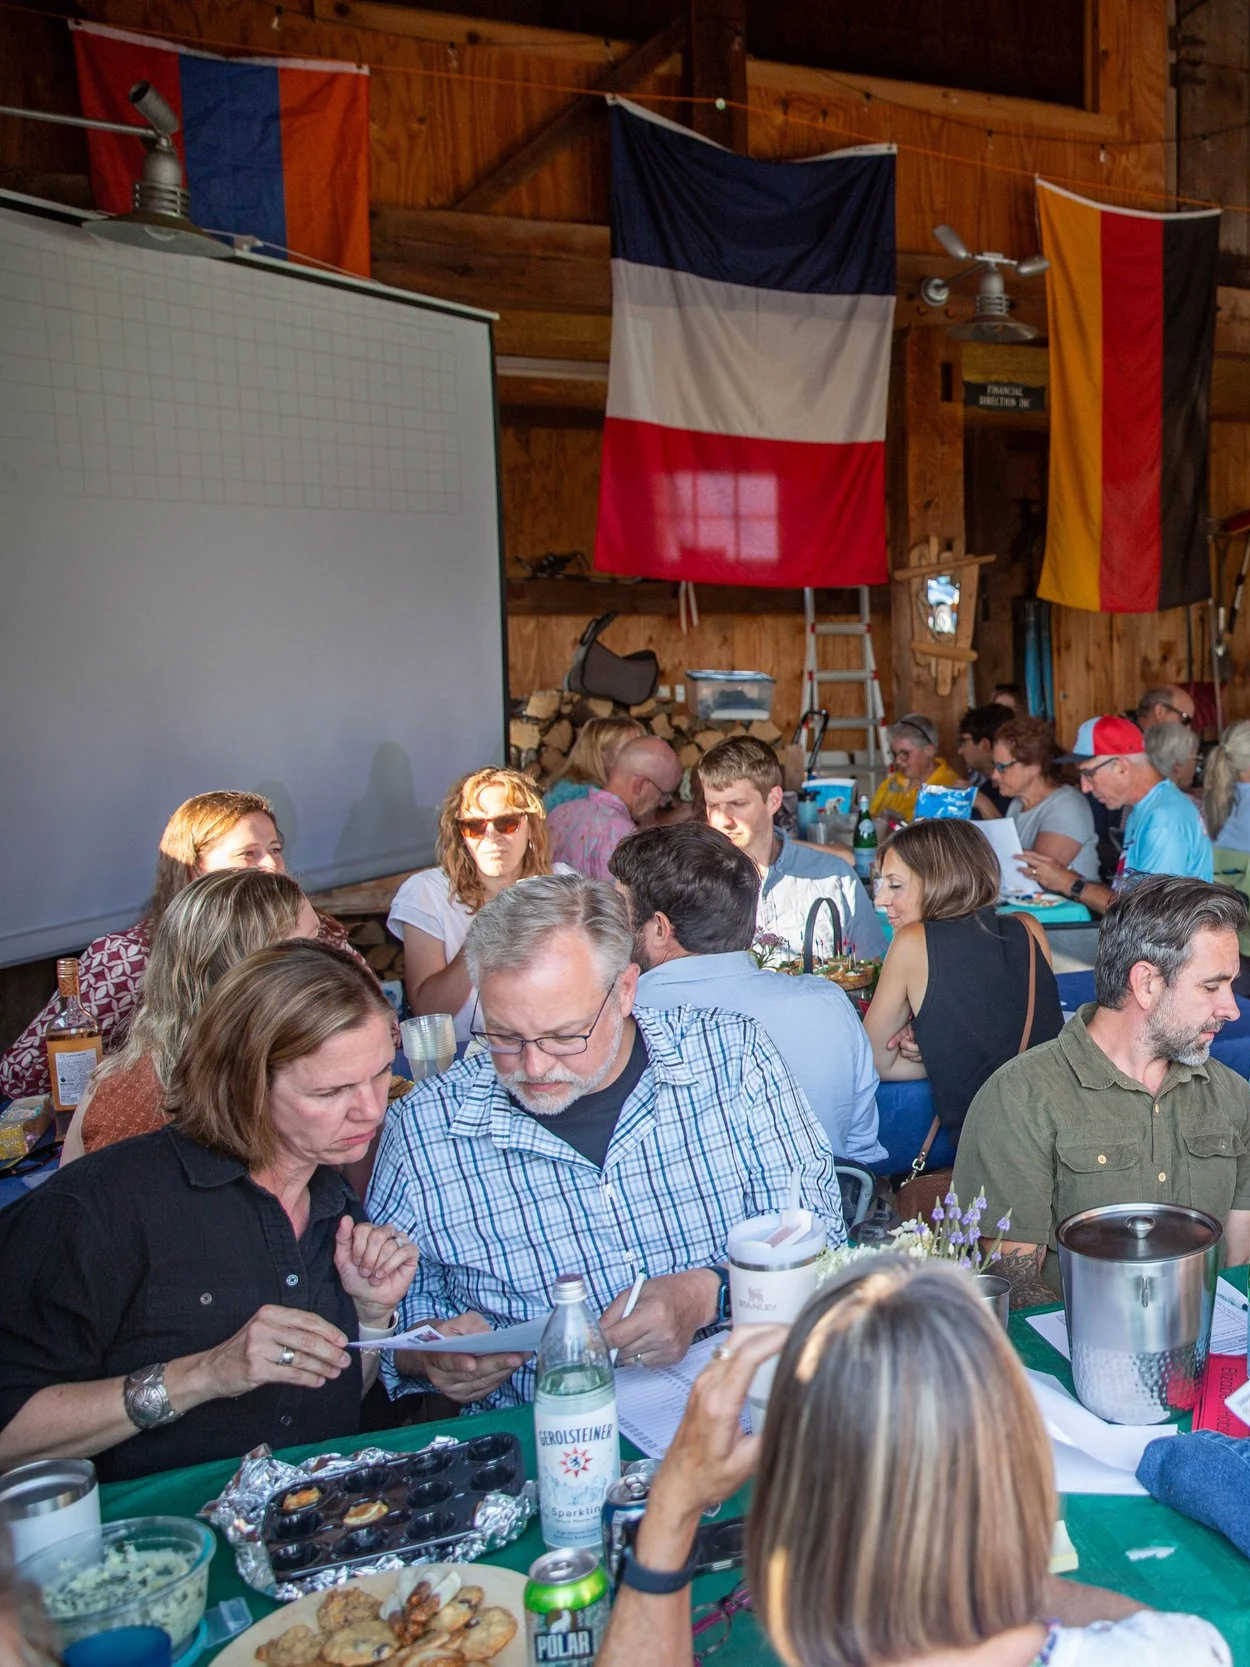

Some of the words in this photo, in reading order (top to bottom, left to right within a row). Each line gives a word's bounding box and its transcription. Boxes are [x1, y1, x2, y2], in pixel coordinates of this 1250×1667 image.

[538, 1423, 613, 1447] GEROLSTEINER
[552, 1505, 601, 1518] Sparklin
[537, 1631, 591, 1659] POLAR
